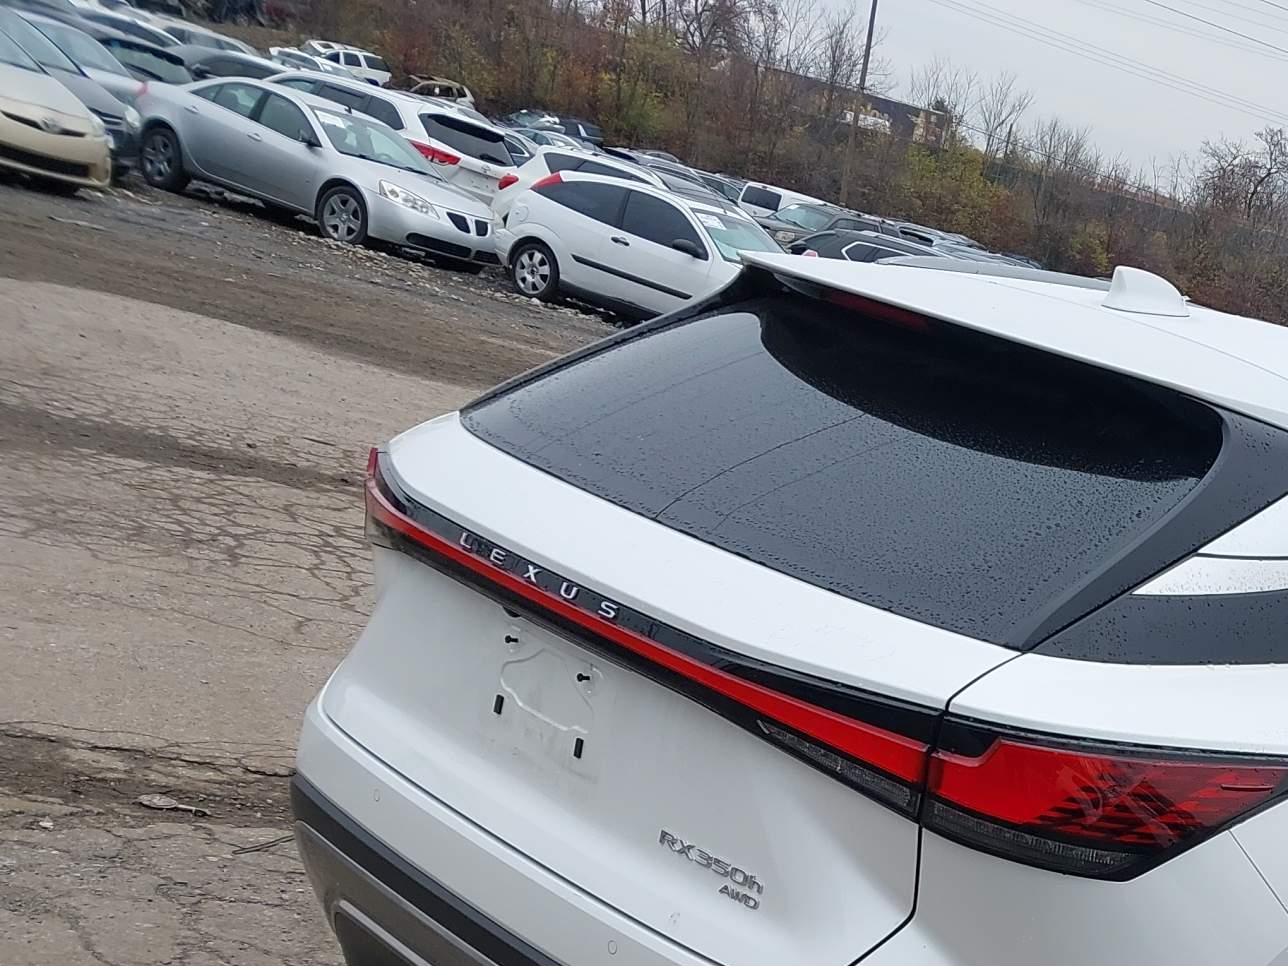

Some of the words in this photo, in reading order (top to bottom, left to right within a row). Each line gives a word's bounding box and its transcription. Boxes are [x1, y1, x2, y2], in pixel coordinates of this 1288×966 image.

[459, 532, 619, 620] LEXUS
[658, 829, 764, 895] RX350h
[718, 884, 760, 910] AWD
